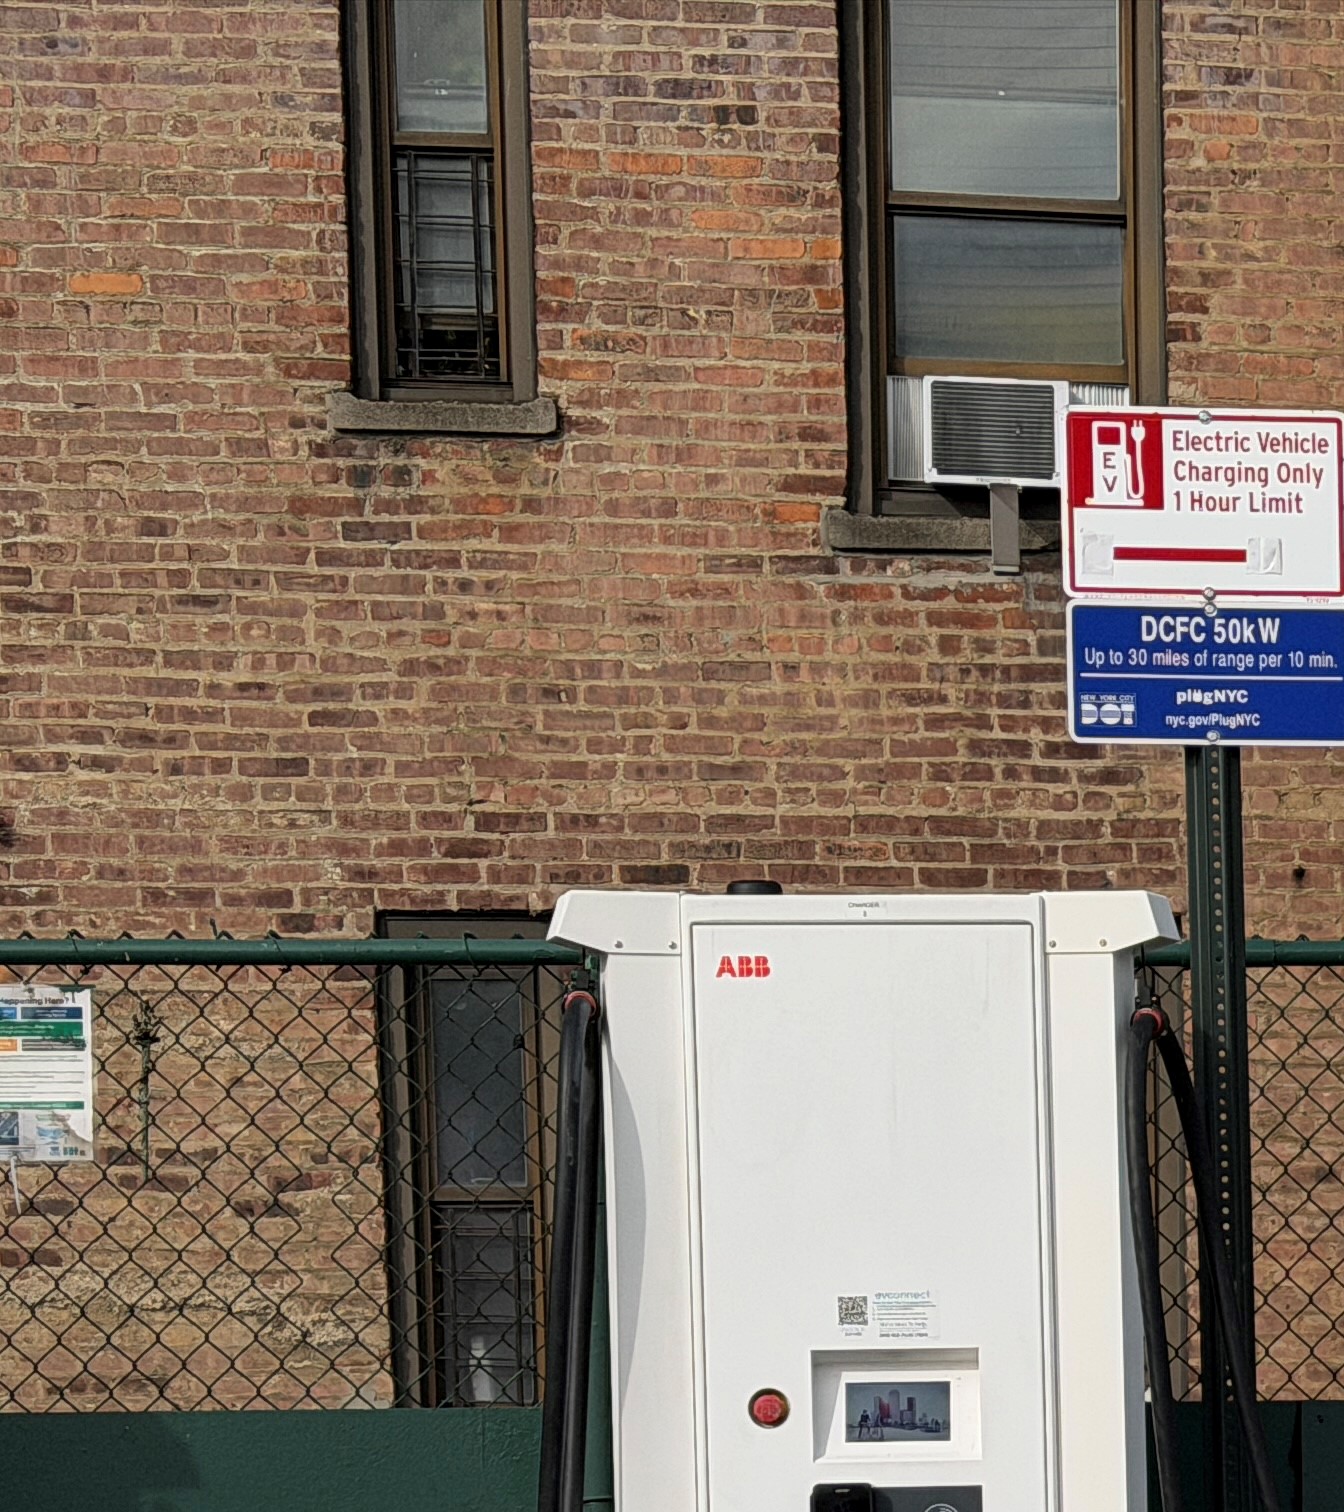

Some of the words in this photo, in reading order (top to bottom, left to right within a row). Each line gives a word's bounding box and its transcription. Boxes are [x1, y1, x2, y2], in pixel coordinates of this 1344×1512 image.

[1172, 430, 1251, 454] Electric
[1257, 431, 1330, 455] Vehicle
[1103, 451, 1117, 469] E
[1102, 475, 1118, 493] V
[1173, 461, 1269, 488] Charging
[1276, 462, 1324, 489] Only
[1173, 491, 1182, 512] 1
[1190, 491, 1242, 513] Hour
[1248, 492, 1304, 514] Limit
[1141, 615, 1207, 644] DCFC
[1213, 616, 1281, 644] 50kW
[1084, 648, 1105, 668] Up
[1109, 649, 1123, 666] to
[1128, 649, 1148, 666] 30
[1152, 649, 1190, 667] miles
[1194, 650, 1209, 667] of
[1212, 653, 1255, 671] range
[1259, 653, 1282, 671] per
[1287, 650, 1304, 668] 10
[1308, 651, 1338, 669] min.
[1176, 688, 1249, 706] plugNYC
[1165, 712, 1261, 729] nyc.gov/PlugNYC
[716, 956, 771, 977] ABB
